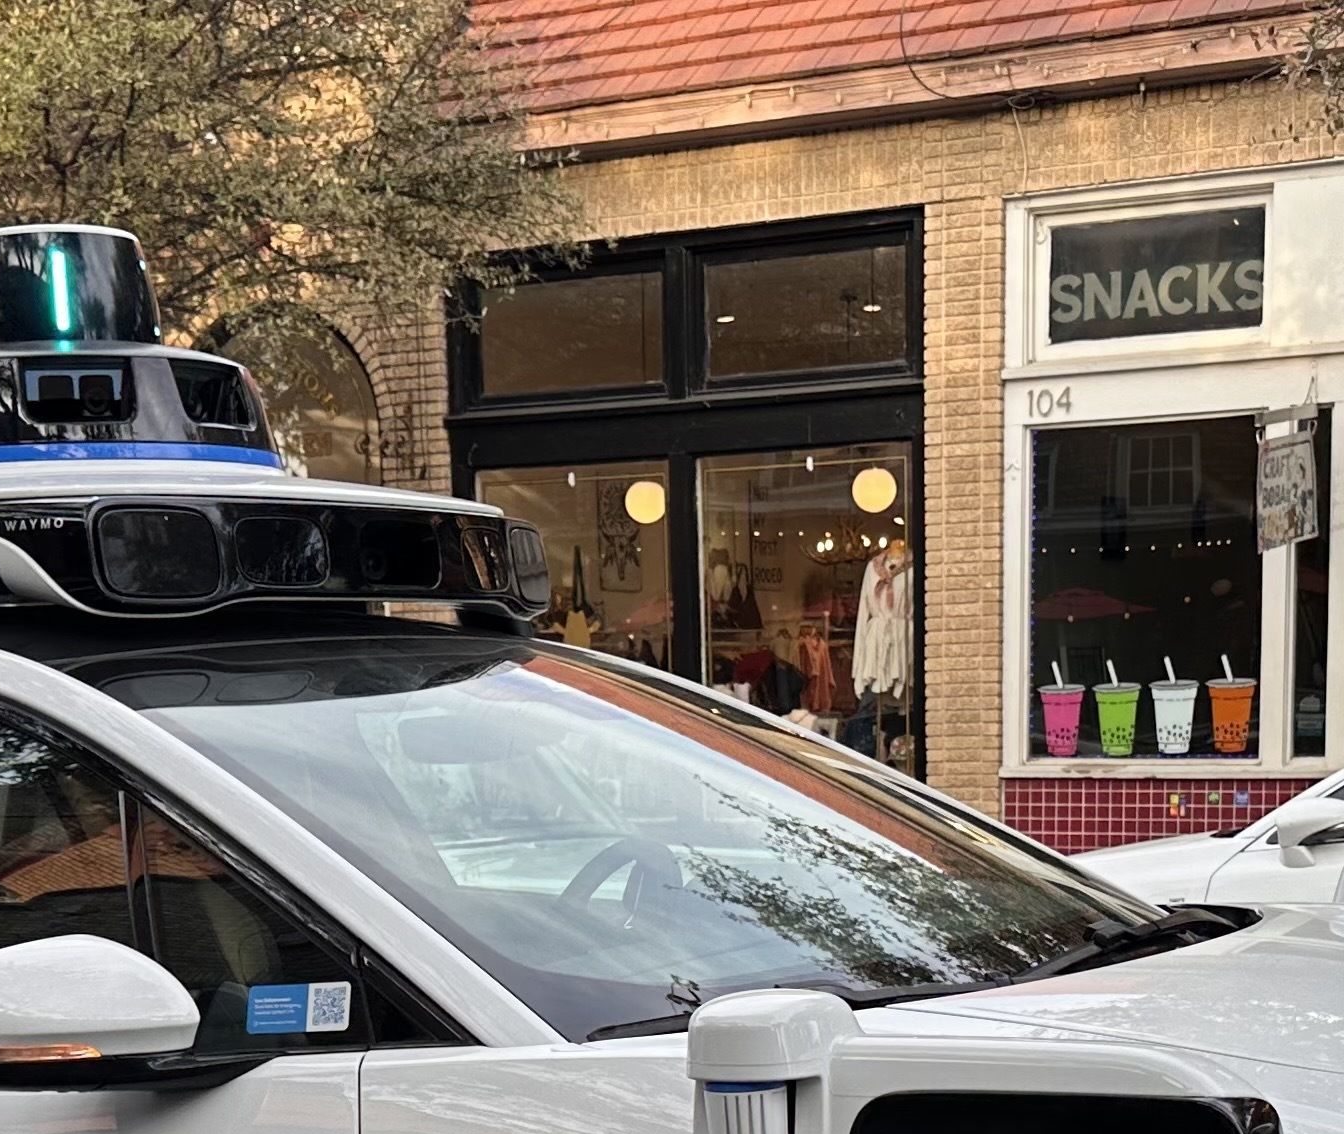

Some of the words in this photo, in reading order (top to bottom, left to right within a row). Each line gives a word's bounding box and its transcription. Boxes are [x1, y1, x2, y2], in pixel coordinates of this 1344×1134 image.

[1052, 260, 1264, 324] SNACKS
[1027, 386, 1072, 418] 104
[4, 518, 64, 531] WAYMO
